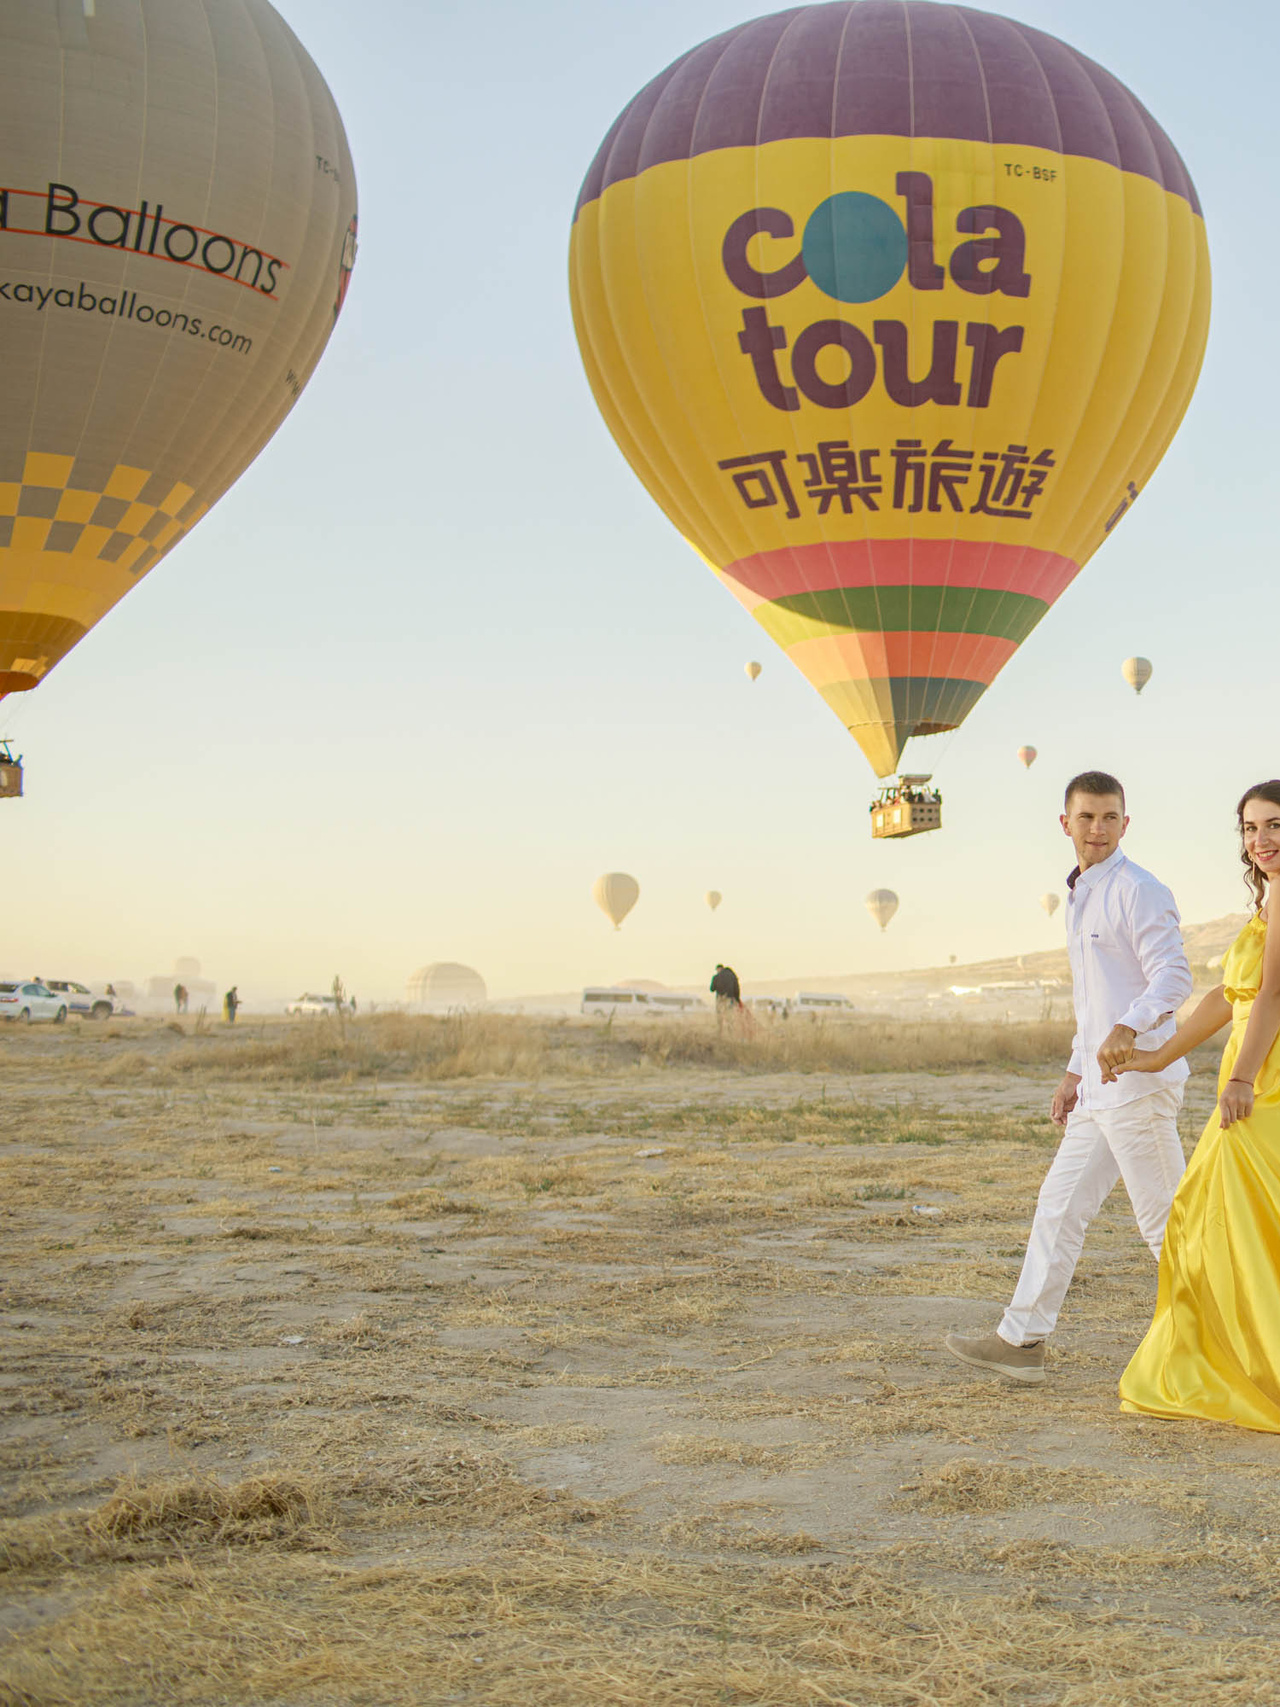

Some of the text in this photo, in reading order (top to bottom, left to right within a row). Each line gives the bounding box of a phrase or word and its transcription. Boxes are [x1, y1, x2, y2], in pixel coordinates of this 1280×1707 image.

[1003, 163, 1057, 183] TC-BSF
[45, 183, 283, 294] Balloons
[722, 171, 1031, 303] cola
[738, 306, 1025, 412] tour
